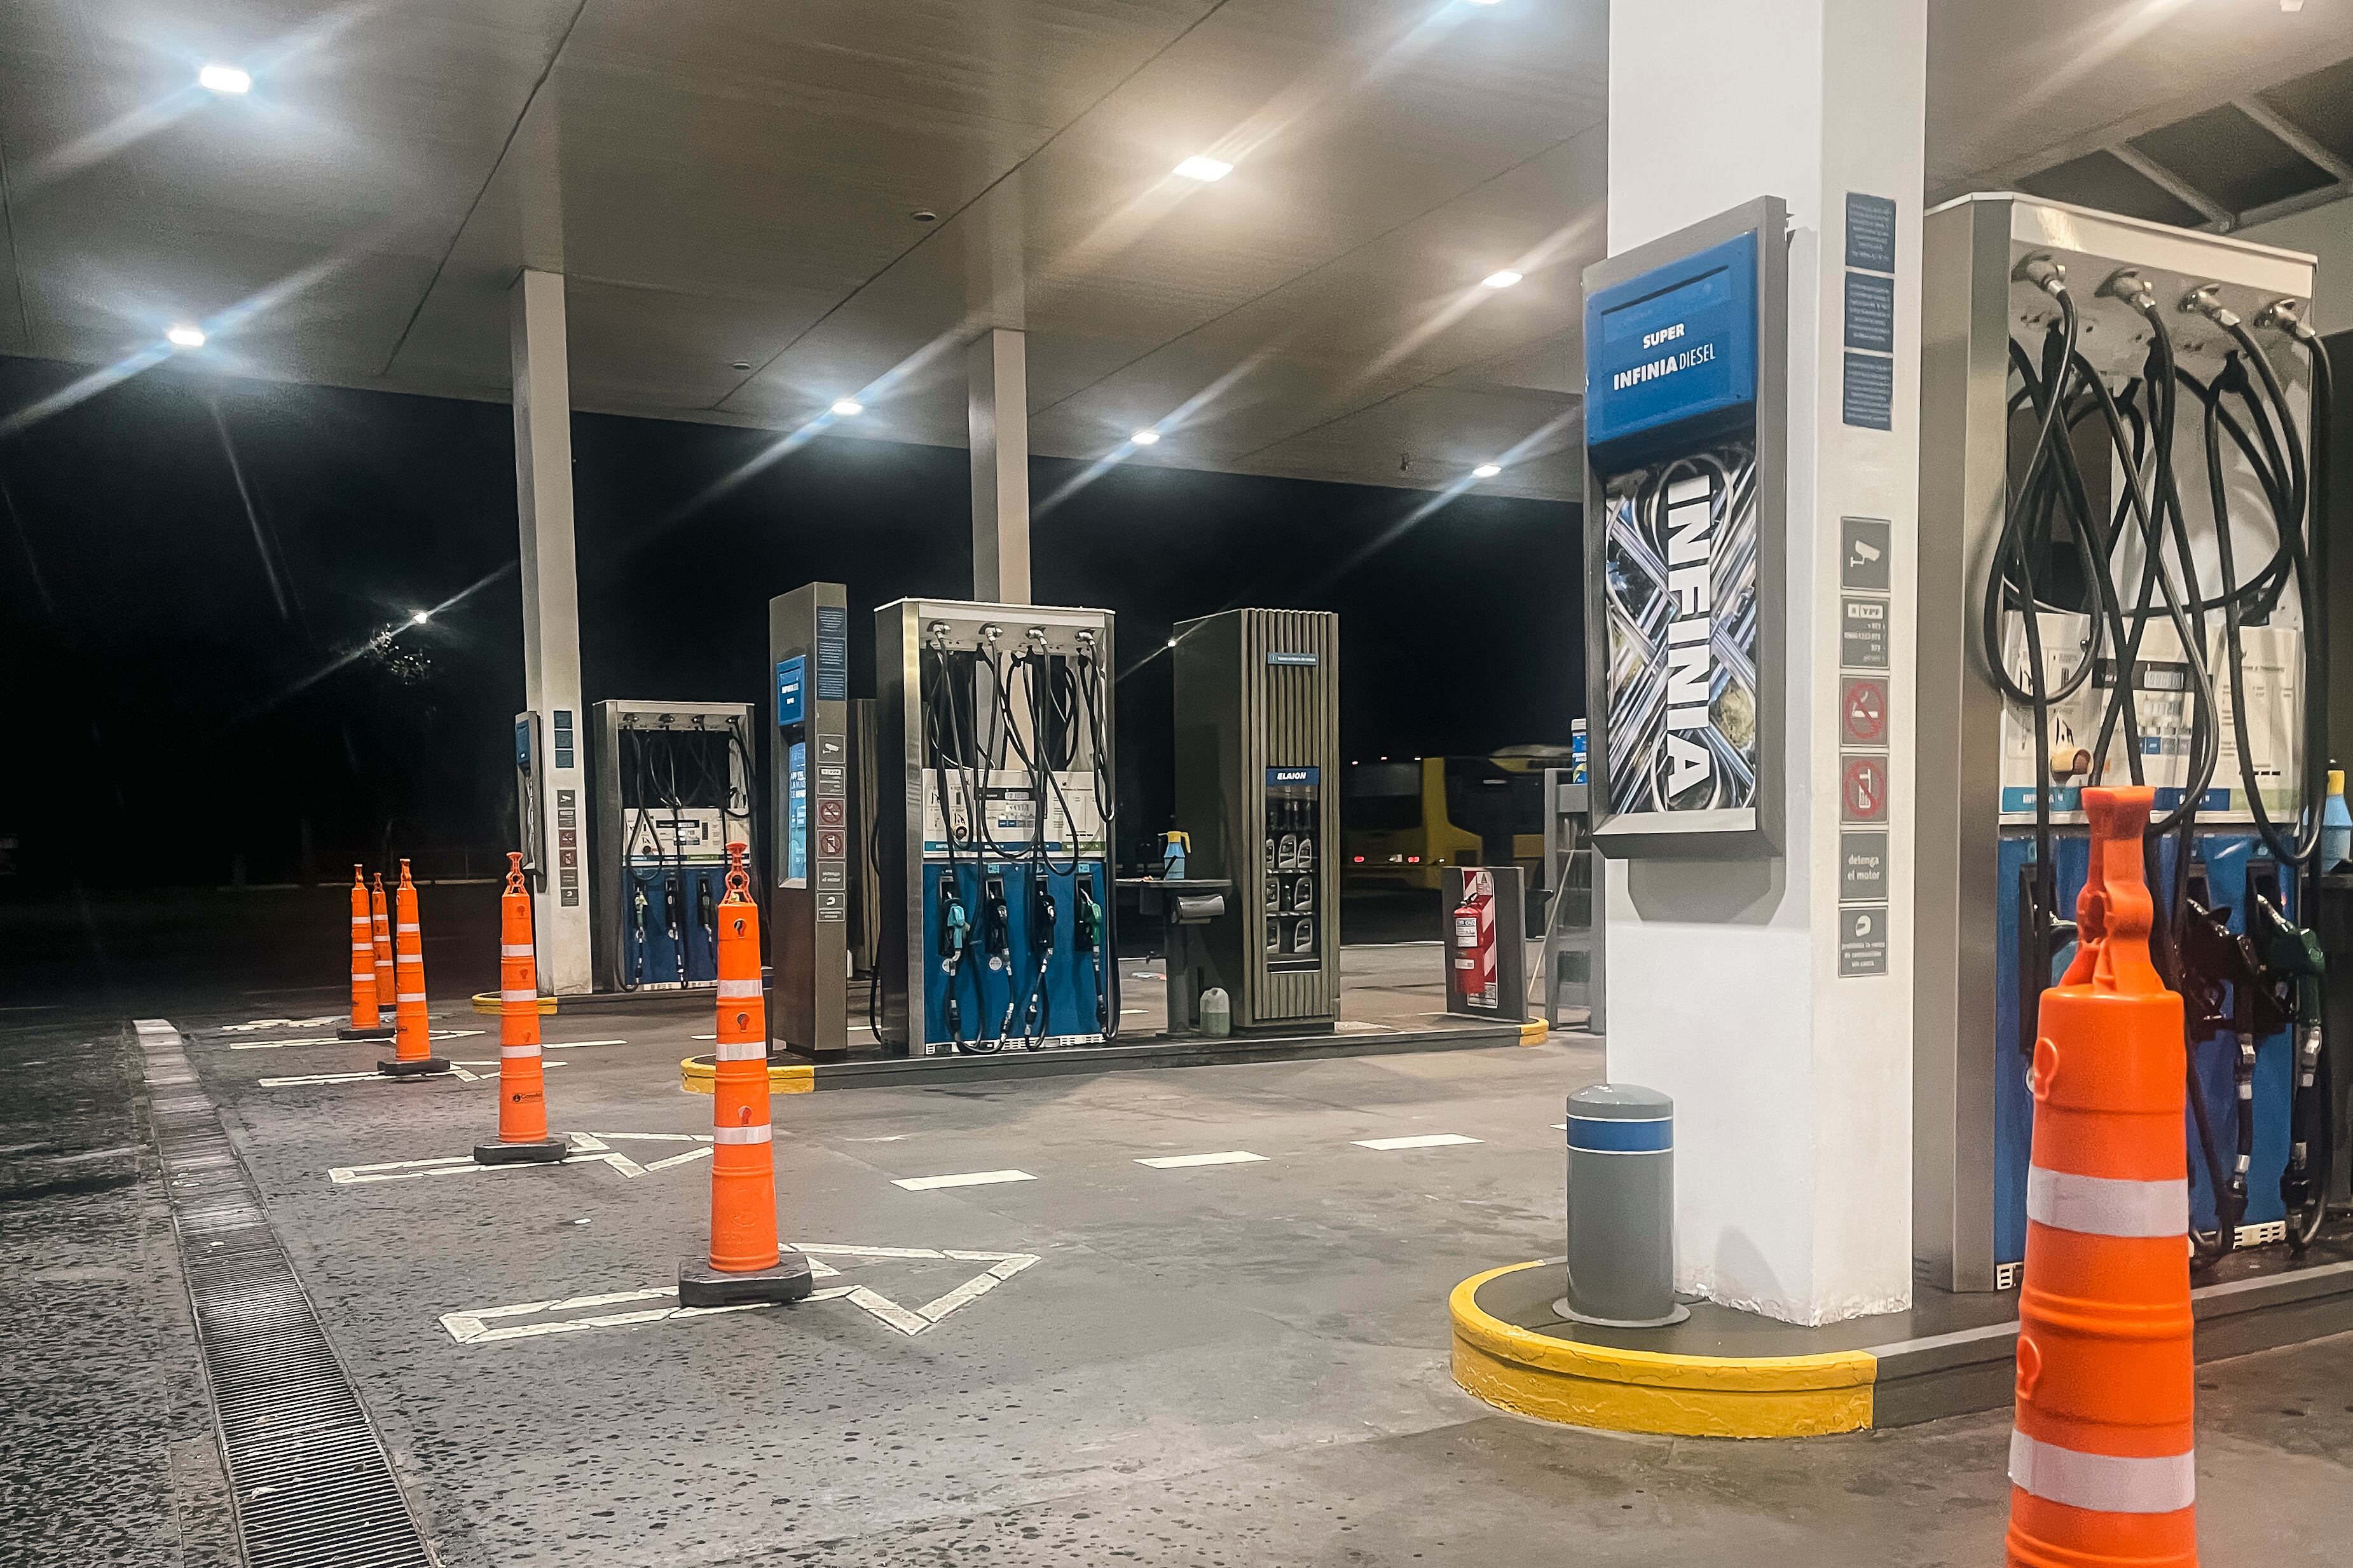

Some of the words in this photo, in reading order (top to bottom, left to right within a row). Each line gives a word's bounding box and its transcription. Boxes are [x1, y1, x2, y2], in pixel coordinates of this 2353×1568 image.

[1642, 322, 1685, 350] SUPER
[1667, 475, 1711, 798] INFINIA
[1277, 772, 1307, 781] ELAION
